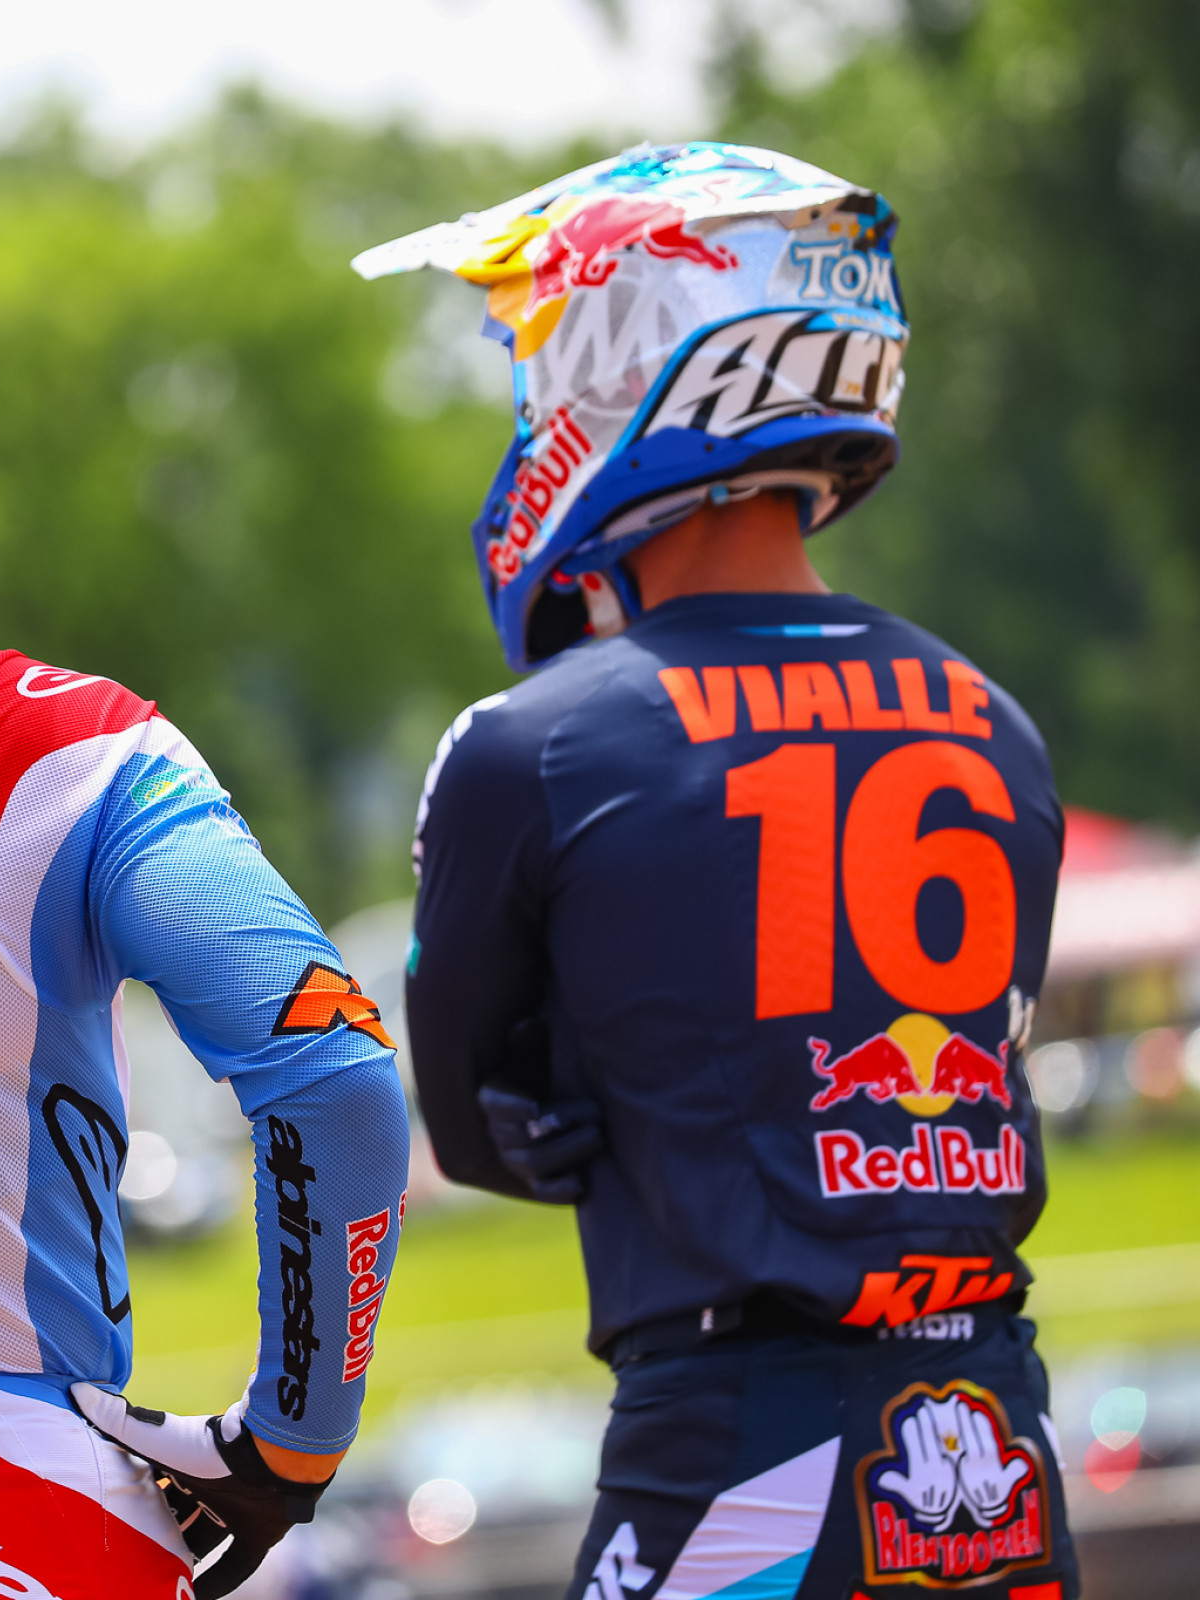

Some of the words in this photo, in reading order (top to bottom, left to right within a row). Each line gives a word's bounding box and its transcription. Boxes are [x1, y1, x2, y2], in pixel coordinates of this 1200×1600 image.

[790, 240, 901, 315] TOM
[658, 658, 993, 744] VIALLE
[725, 739, 1017, 1020] 16
[267, 1114, 322, 1423] alpinestars
[877, 1312, 975, 1341] HOR
